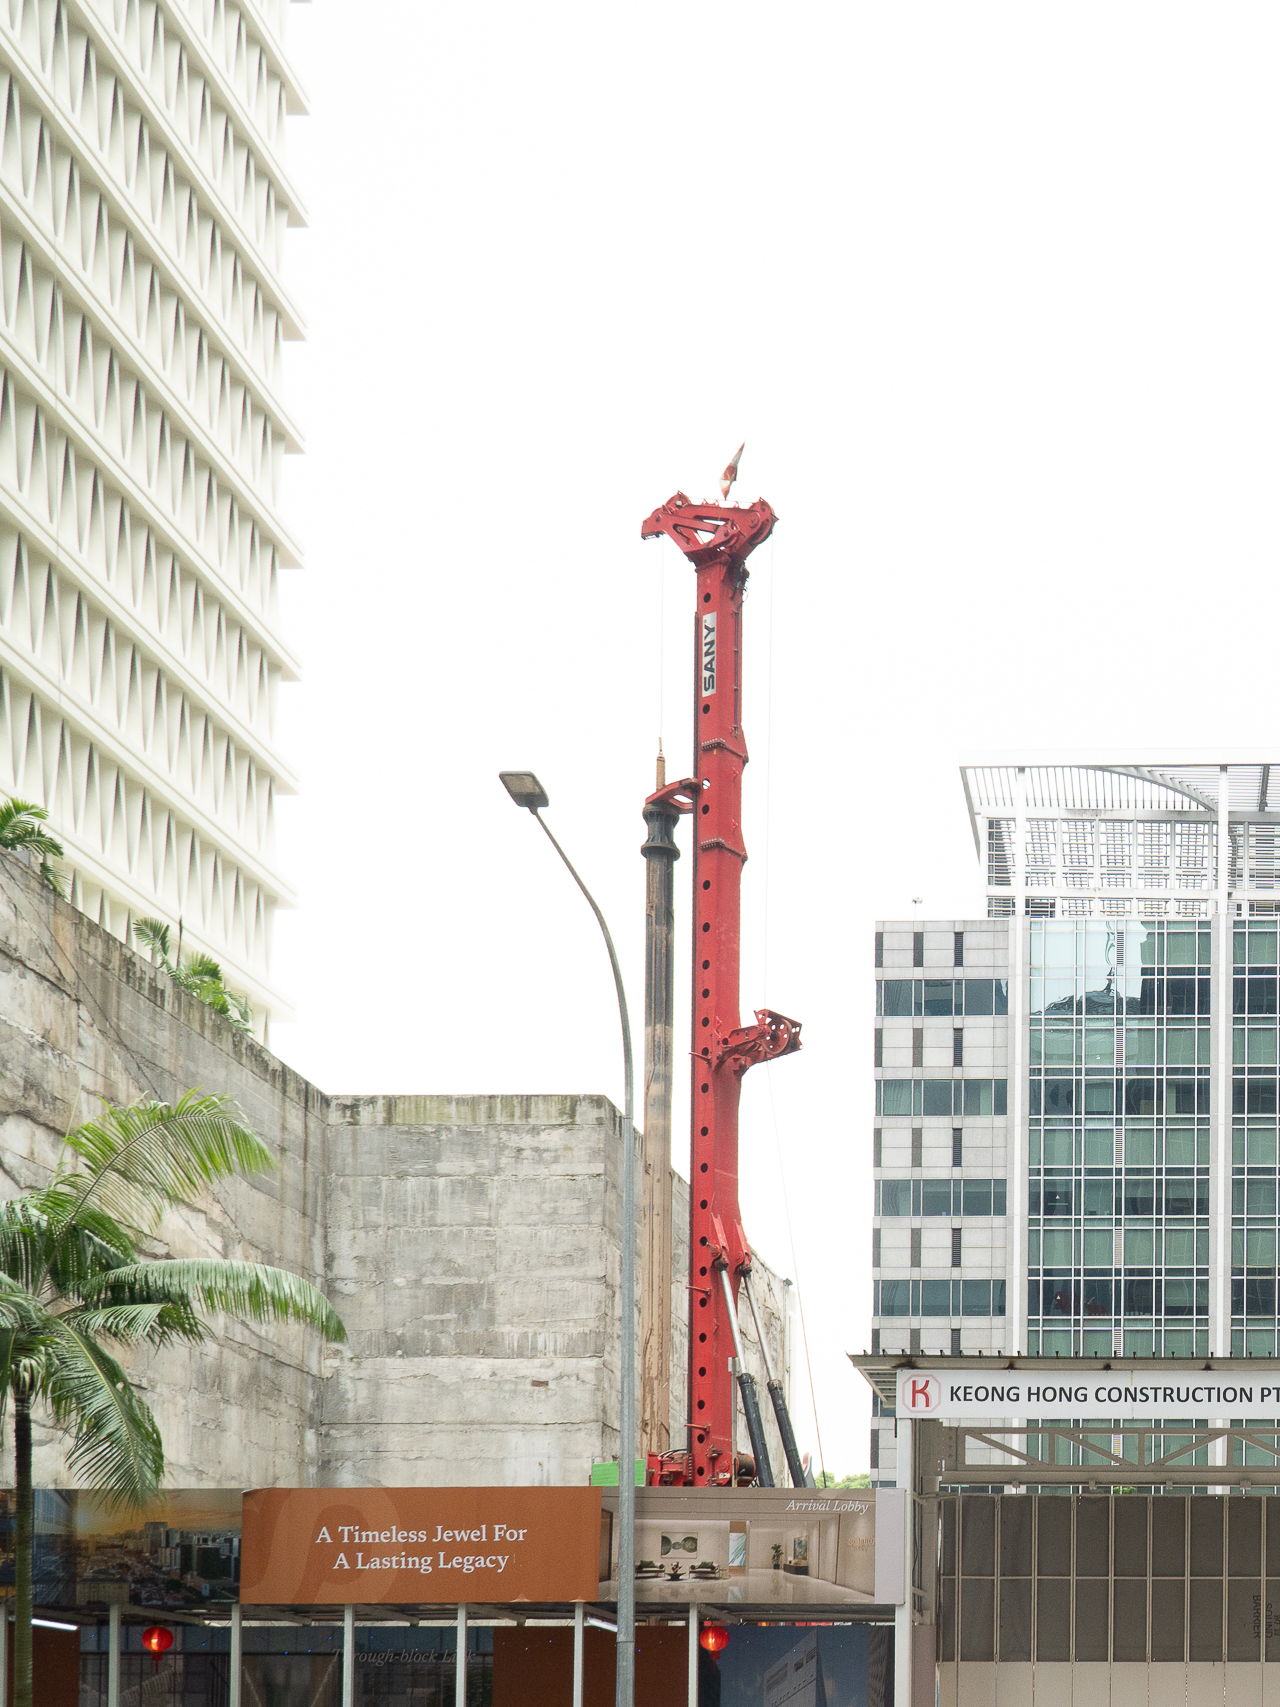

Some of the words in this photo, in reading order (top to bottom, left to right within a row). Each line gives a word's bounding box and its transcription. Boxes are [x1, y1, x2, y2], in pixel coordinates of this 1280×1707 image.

[703, 623, 716, 692] SANY
[950, 1385, 1021, 1402] KEONG
[1027, 1386, 1088, 1403] HONG
[1094, 1386, 1253, 1403] CONSTRUCTION
[785, 1499, 831, 1511] Arrival
[832, 1500, 869, 1516] Lobby
[315, 1526, 333, 1543] A
[338, 1524, 427, 1543] Timeless
[432, 1524, 488, 1542] Jewel
[493, 1524, 528, 1542] For
[333, 1552, 351, 1570] A
[356, 1551, 433, 1574] Lasting
[438, 1551, 510, 1574] Legacy
[1252, 1594, 1262, 1639] BARRIER
[1265, 1602, 1273, 1639] SOUND
[331, 1648, 438, 1667] Trough-block
[441, 1648, 476, 1663] Lik
